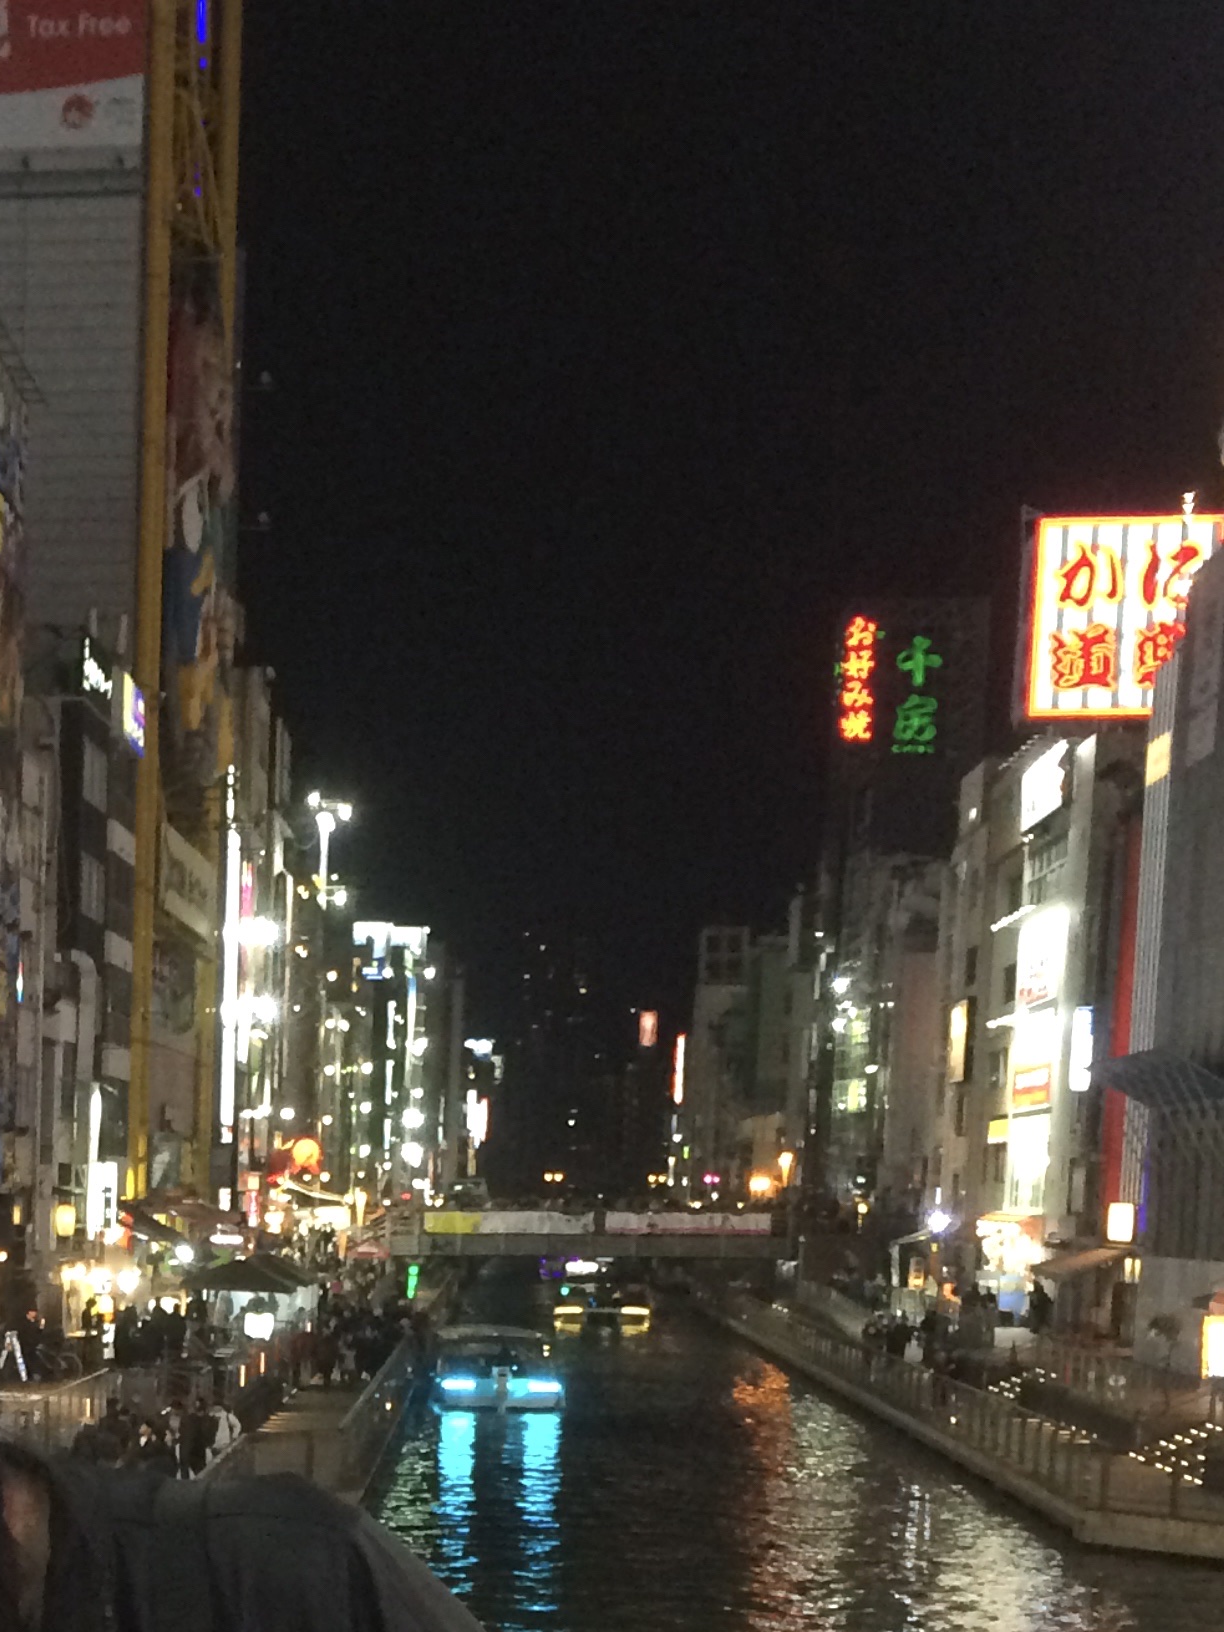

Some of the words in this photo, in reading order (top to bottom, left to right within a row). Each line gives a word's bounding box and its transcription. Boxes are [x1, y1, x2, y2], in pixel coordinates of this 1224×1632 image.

[27, 15, 70, 38] Tax
[79, 12, 132, 37] Free
[1055, 539, 1203, 610] かに
